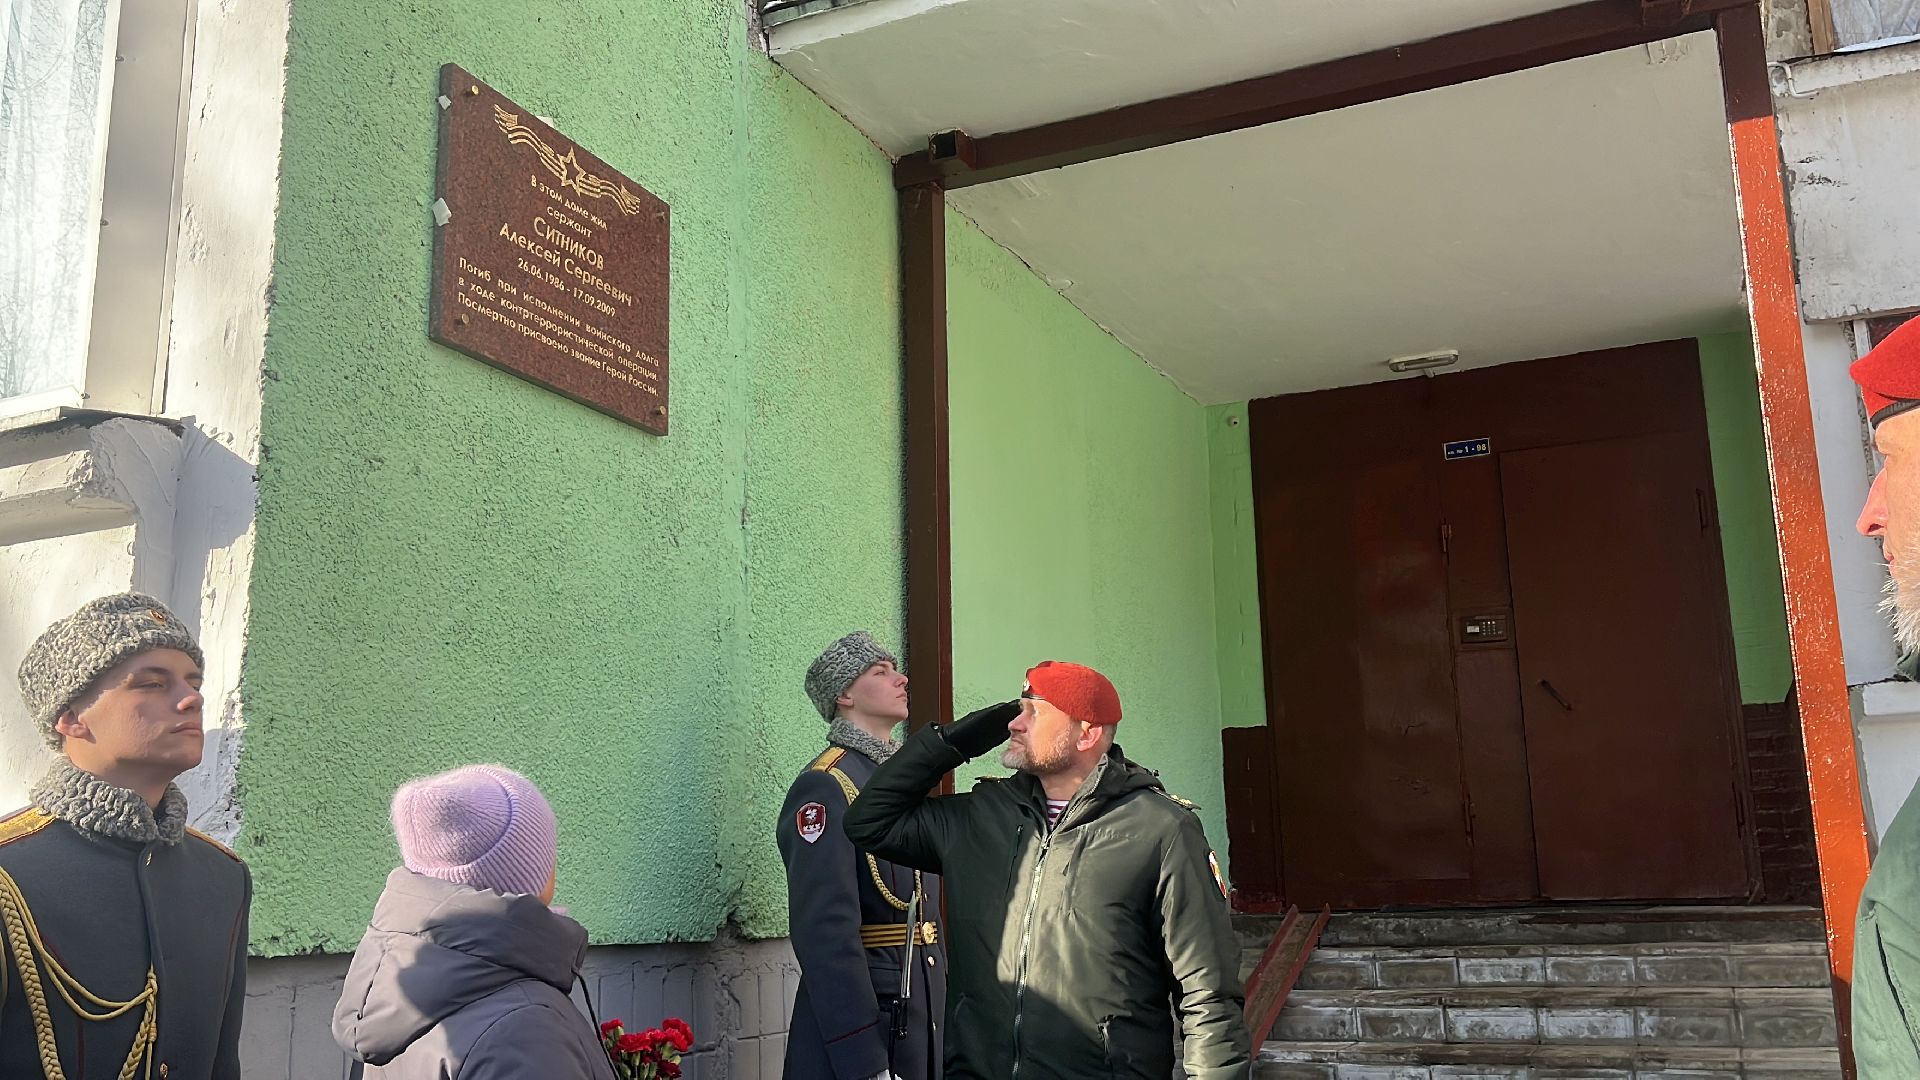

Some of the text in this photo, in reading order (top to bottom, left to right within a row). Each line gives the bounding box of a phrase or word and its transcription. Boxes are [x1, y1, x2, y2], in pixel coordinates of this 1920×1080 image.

[531, 175, 608, 231] В этом доме жил
[547, 206, 592, 238] сержант
[500, 223, 632, 307] Алексей Сергеевич
[518, 257, 565, 291] 26.06.1986
[573, 287, 616, 317] 17.09.2009
[458, 276, 659, 382] в ходе контртеррористической операции.
[458, 291, 659, 397] Посмертно присвоено звание Герой России.
[460, 257, 659, 367] Погиб при исполнении воинского долга
[1464, 445, 1469, 453] 1
